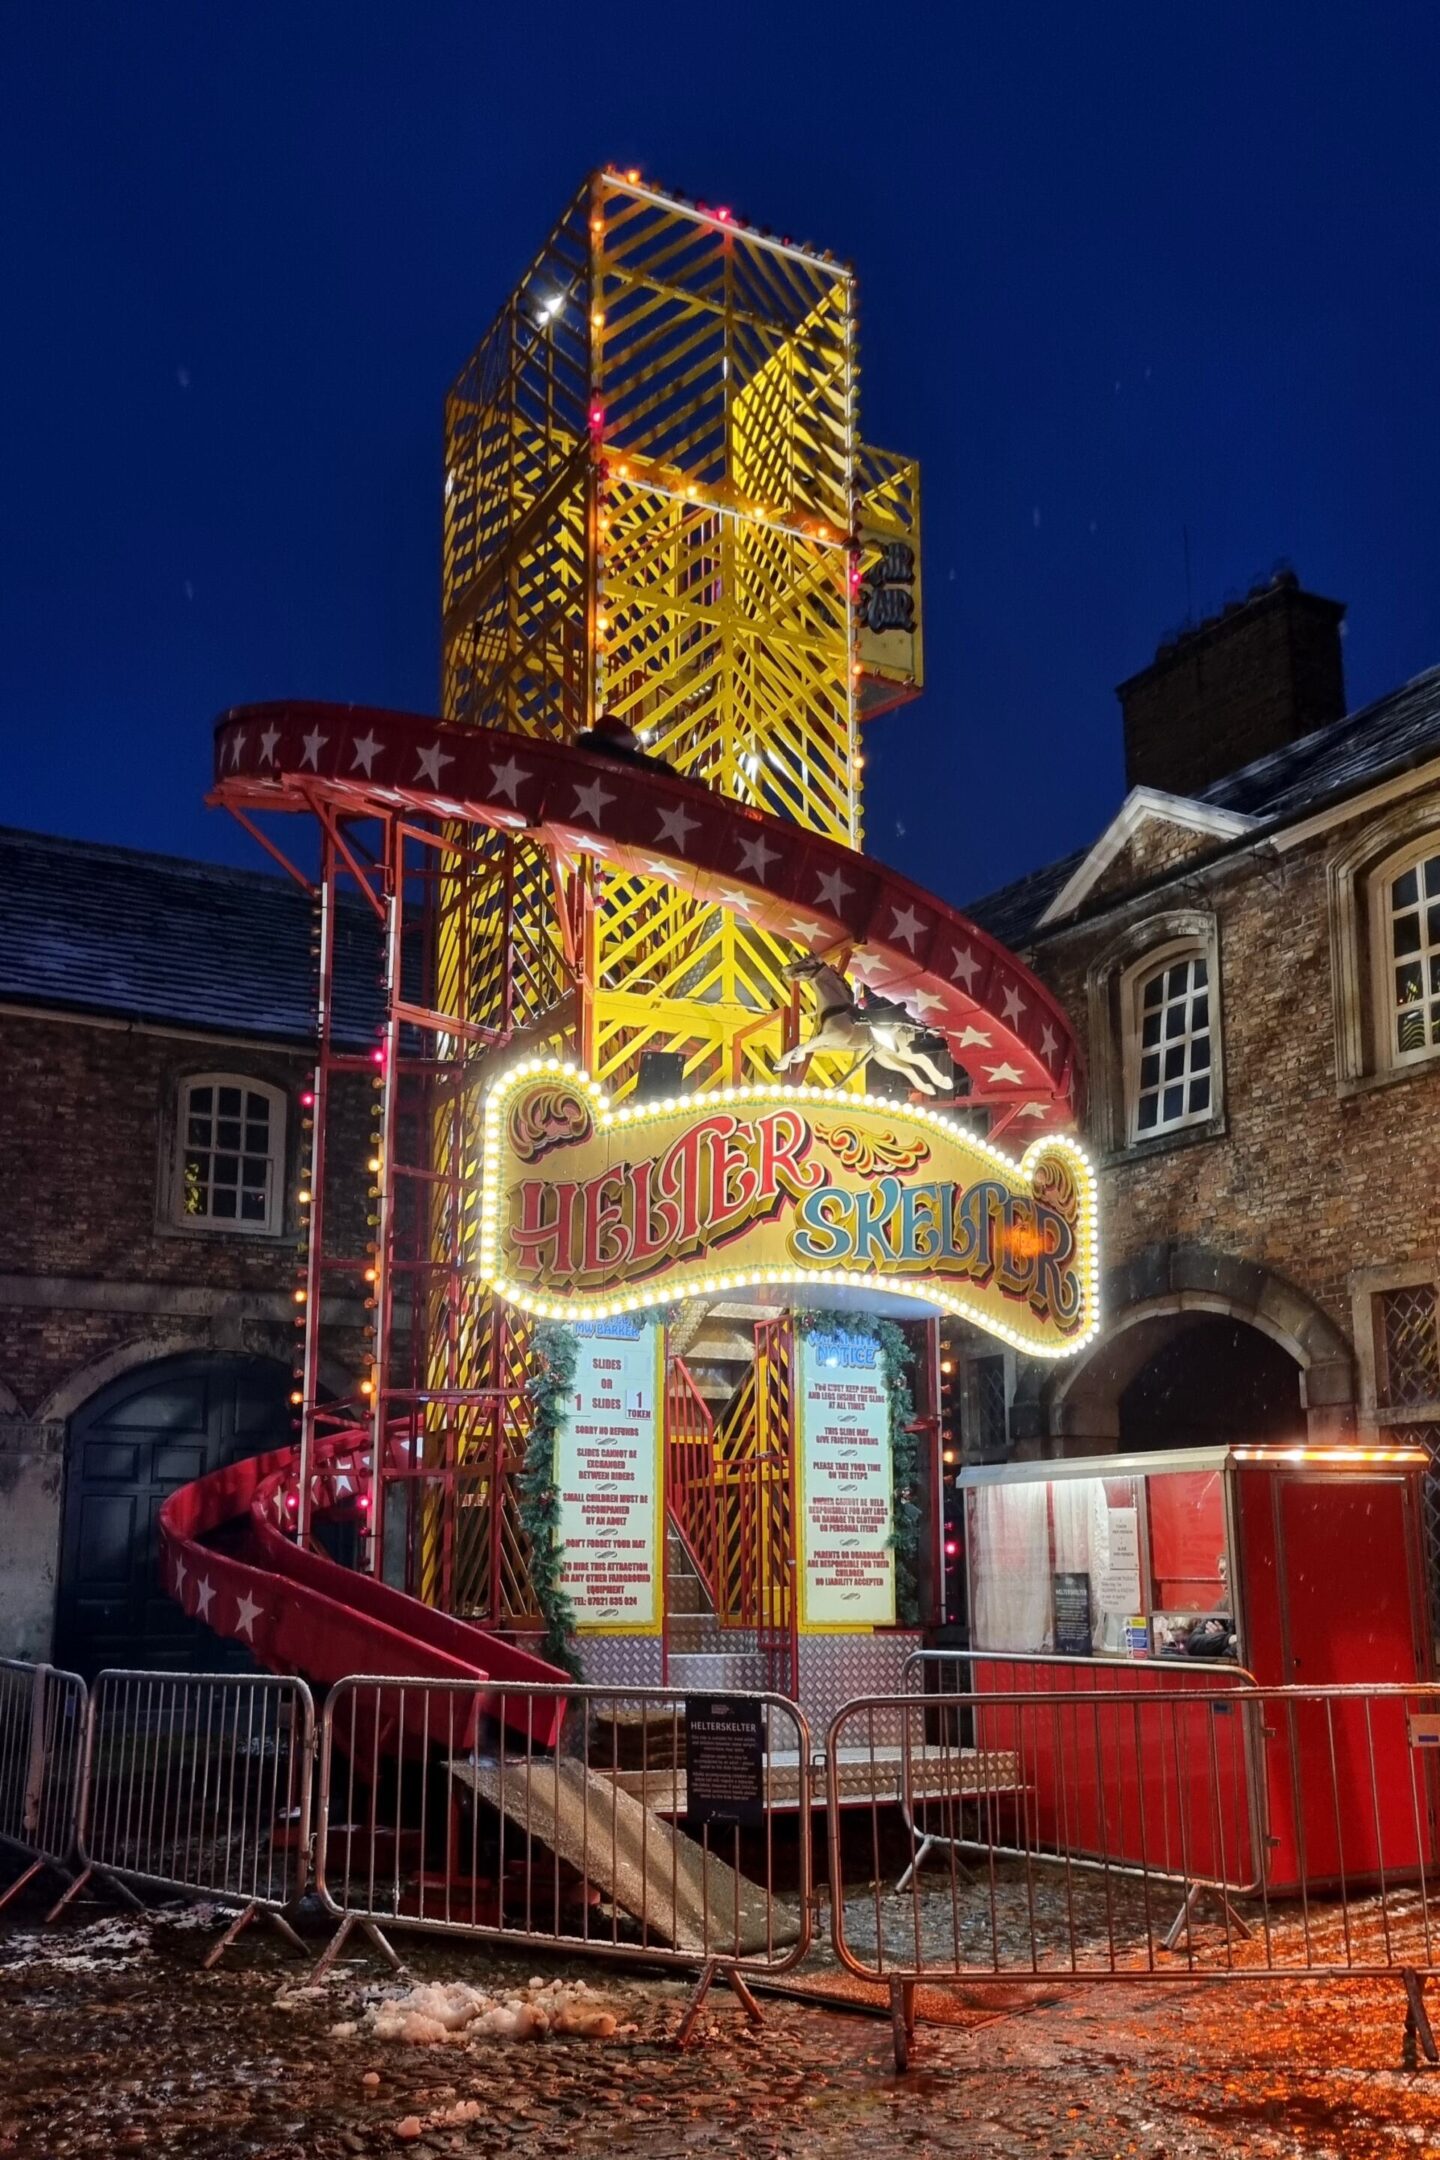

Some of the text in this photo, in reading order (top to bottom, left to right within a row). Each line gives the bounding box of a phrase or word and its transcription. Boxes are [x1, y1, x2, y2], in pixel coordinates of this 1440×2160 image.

[508, 1107, 824, 1282] HELTER
[793, 1175, 1082, 1320] SKELTER
[817, 1347, 876, 1368] NOTICE
[593, 1359, 621, 1370] SLIDES
[601, 1379, 612, 1389] OR
[828, 1384, 844, 1392] MUST
[861, 1386, 877, 1394] ARMS
[575, 1393, 581, 1411] 1
[636, 1392, 642, 1408] 1
[822, 1392, 835, 1400] LEGS
[837, 1393, 855, 1401] INSIDE
[857, 1394, 867, 1402] THE
[869, 1395, 884, 1403] SLIDE
[592, 1398, 621, 1409] SLIDES
[829, 1401, 835, 1409] AT
[848, 1402, 865, 1410] TIMES
[628, 1410, 650, 1418] TOKEN
[576, 1425, 639, 1436] SORRY NO REFUNDS
[825, 1427, 838, 1435] THIS
[840, 1428, 855, 1436] SLIDE
[816, 1435, 878, 1445] GIVE FRICTION BURNS
[577, 1448, 636, 1458] SLIDES CANNOT BE
[587, 1460, 625, 1469] EXCHANGED
[813, 1462, 833, 1470] PLEASE
[851, 1463, 865, 1471] YOUR
[868, 1464, 881, 1472] TIME
[579, 1471, 634, 1480] BETWEEN RIDERS
[850, 1472, 867, 1480] STEPS
[563, 1493, 648, 1503] SMALL CHILDREN MUST BE
[836, 1498, 858, 1506] CANNOT
[582, 1505, 629, 1514] ACCOMPANIED
[809, 1506, 847, 1514] RESPONSIBLE
[586, 1517, 627, 1525] BY AN ADULT
[813, 1515, 820, 1523] OR
[822, 1515, 846, 1523] DAMAGE
[857, 1516, 885, 1524] CLOTHING
[820, 1524, 828, 1532] OR
[829, 1524, 858, 1532] PERSONAL
[566, 1539, 645, 1548] DON'T FORGET YOUR MAT
[814, 1551, 840, 1559] PARENTS
[841, 1551, 849, 1559] OR
[563, 1562, 648, 1571] TO HIRE THIS ATTRACTION
[821, 1560, 859, 1568] RESPONSIBLE
[861, 1560, 871, 1568] FOR
[560, 1574, 650, 1582] OR ANY OTHER FAIRGROUND
[587, 1586, 624, 1595] EQUIPMENT
[690, 1721, 757, 1733] HELTERSKELTER
